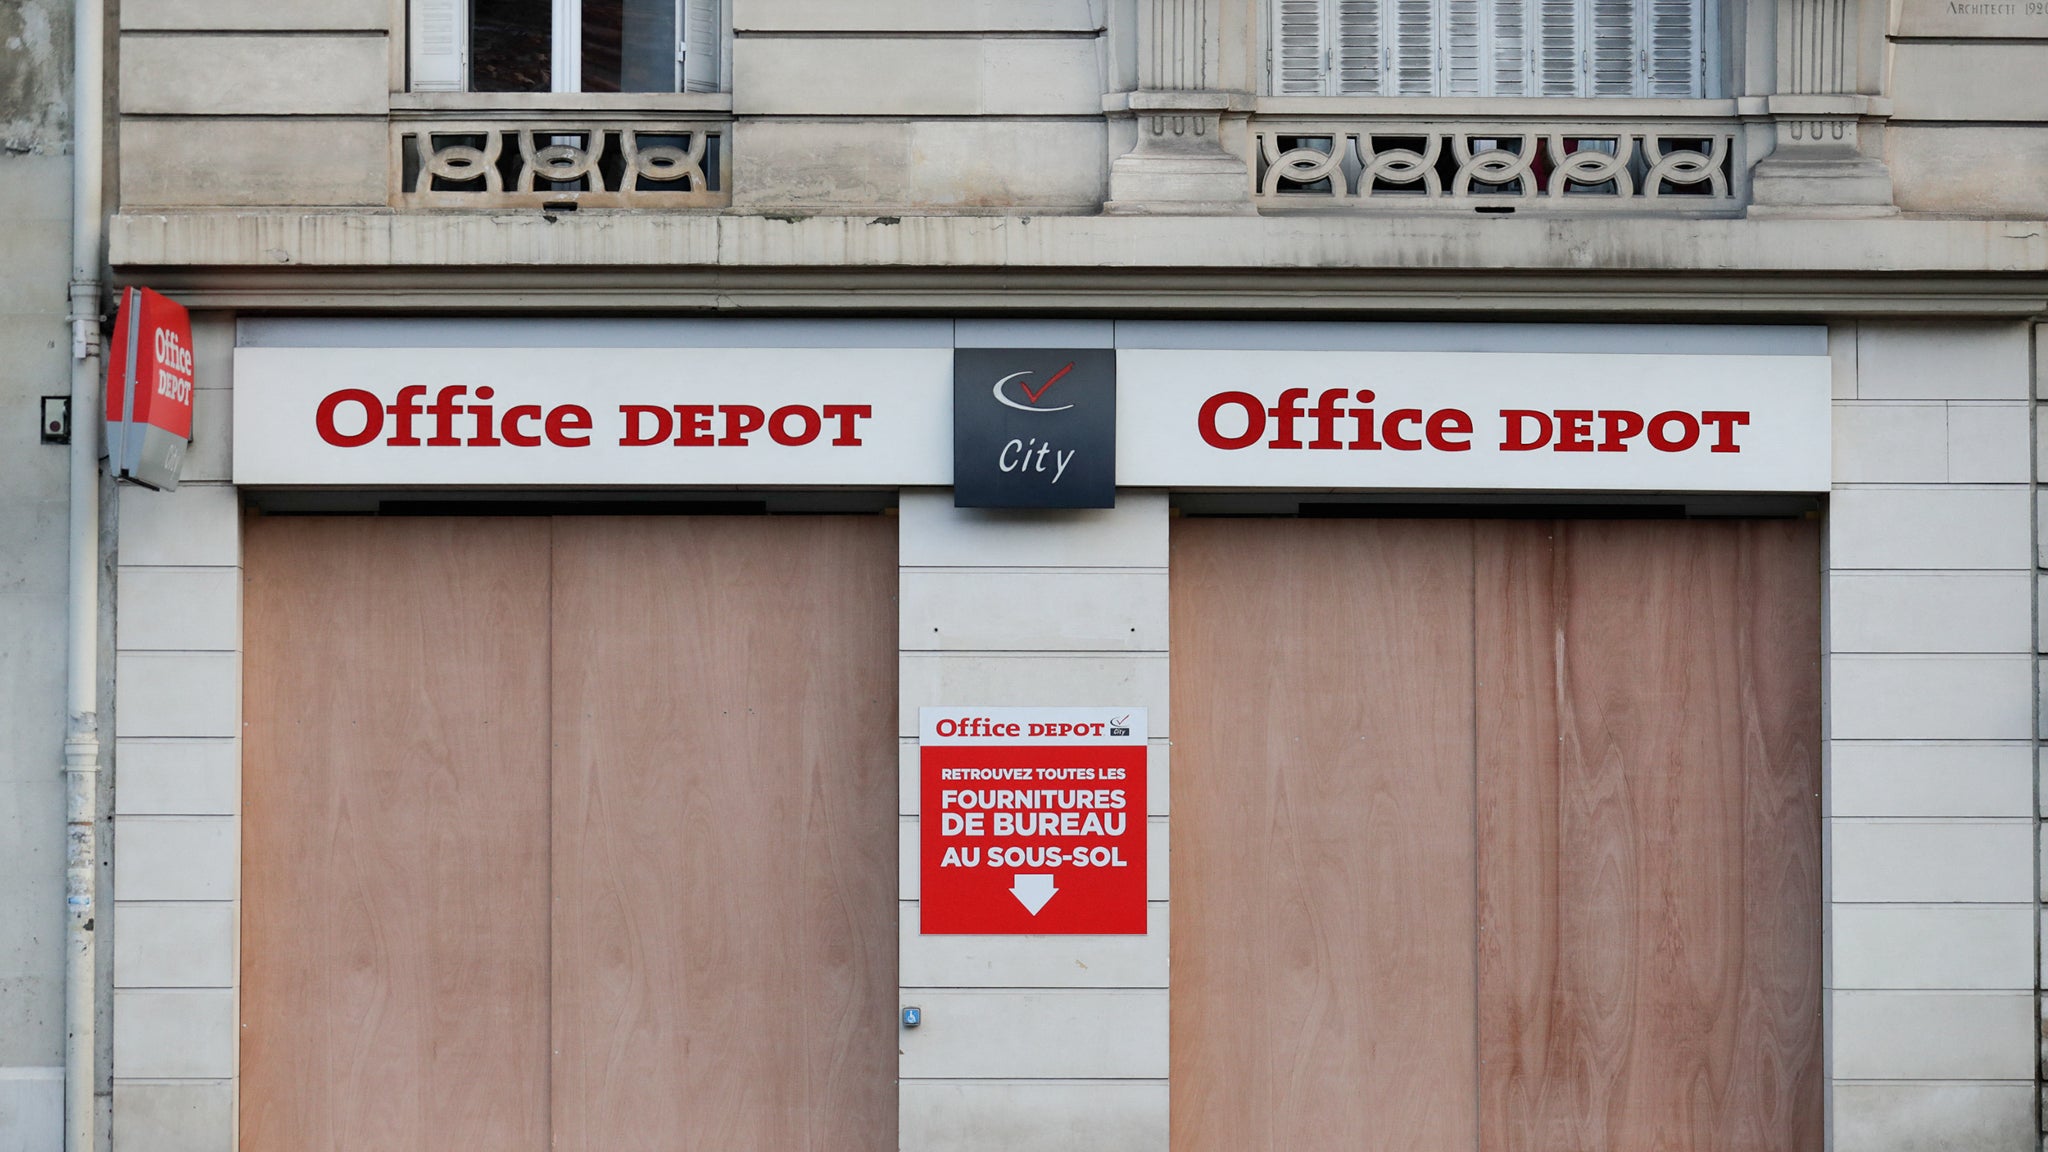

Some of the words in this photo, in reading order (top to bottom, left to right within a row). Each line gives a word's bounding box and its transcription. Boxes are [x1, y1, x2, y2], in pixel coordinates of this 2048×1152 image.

[155, 327, 192, 376] Office
[157, 369, 192, 406] DEPOT
[315, 385, 593, 448] Office
[619, 404, 872, 447] DEPOT
[1197, 388, 1474, 451] Office
[1499, 409, 1750, 453] DEPOT
[999, 438, 1075, 484] City
[935, 718, 1021, 737] Office
[1028, 723, 1105, 737] DEPOT
[941, 768, 1033, 780] RETROUVEZ
[1036, 768, 1095, 780] TOUTES
[1098, 768, 1126, 780] LES
[941, 789, 1127, 809] FOURNITURES
[941, 812, 985, 836] DE
[993, 812, 1127, 837] BUREAU
[940, 846, 981, 868] AU
[987, 846, 1128, 868] SOUS-SOL
